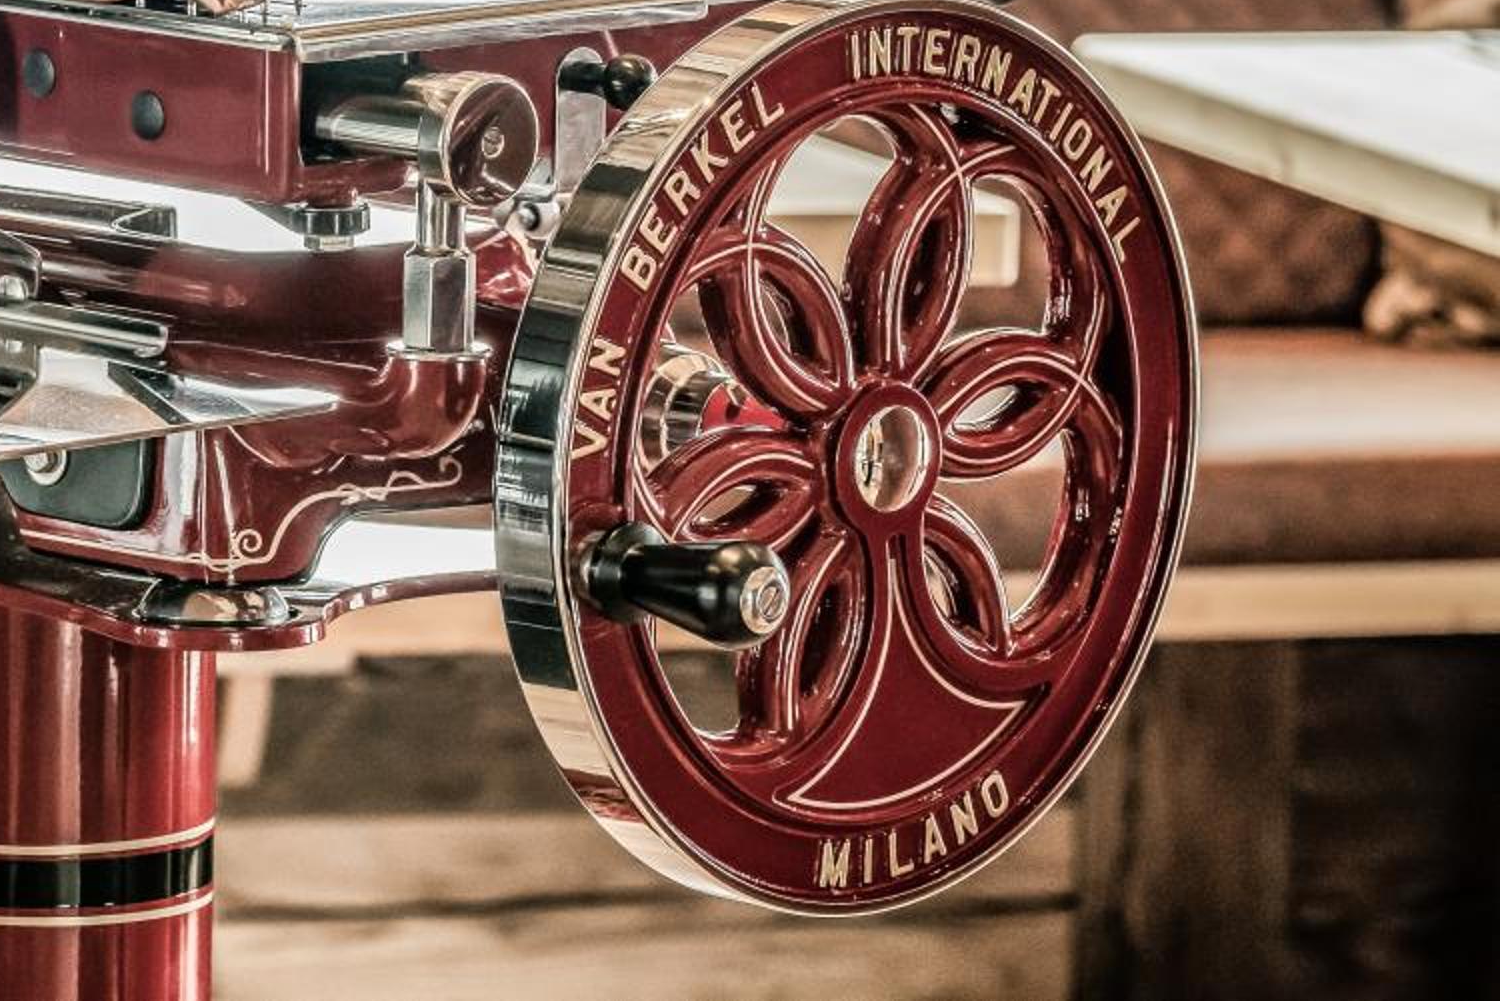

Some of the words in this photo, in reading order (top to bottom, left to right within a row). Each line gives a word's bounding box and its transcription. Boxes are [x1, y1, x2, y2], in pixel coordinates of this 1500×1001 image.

[573, 337, 624, 458] VAN
[620, 82, 785, 292] BERKEL
[849, 25, 1141, 262] INTERNATIONAL
[819, 770, 1010, 888] MILANO
